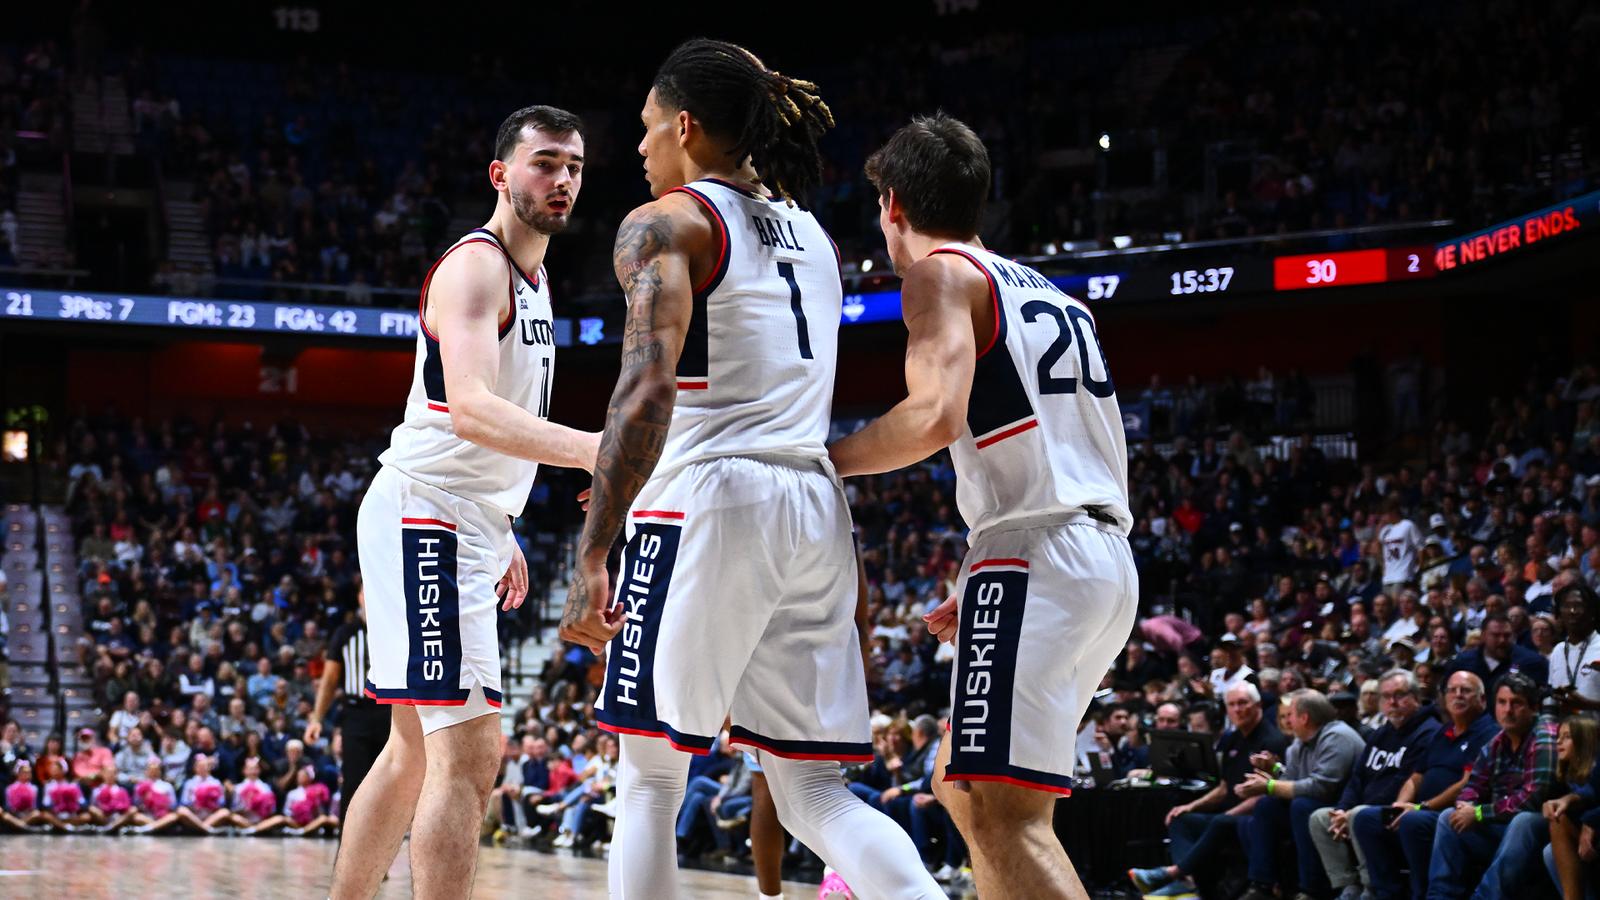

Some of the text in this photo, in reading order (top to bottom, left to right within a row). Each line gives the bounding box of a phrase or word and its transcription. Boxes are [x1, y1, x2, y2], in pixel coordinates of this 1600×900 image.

[272, 7, 320, 33] 113
[752, 215, 805, 252] BALL
[1460, 224, 1521, 265] NEVER
[1525, 206, 1581, 245] ENDS.
[1170, 266, 1235, 295] 15:37
[1305, 258, 1337, 284] 30
[1407, 253, 1421, 273] 2
[1087, 275, 1120, 300] 57
[6, 292, 33, 316] 21
[118, 298, 135, 321] 7
[167, 301, 223, 326] FGM:
[227, 304, 256, 328] 23
[274, 306, 325, 331] FGA:
[328, 310, 358, 333] 42
[777, 261, 814, 360] 1
[1020, 300, 1115, 398] 20
[257, 366, 299, 394] 21
[418, 538, 444, 681] HUSKIES
[617, 533, 661, 706] HUSKIES
[960, 582, 1004, 753] HUSKIES
